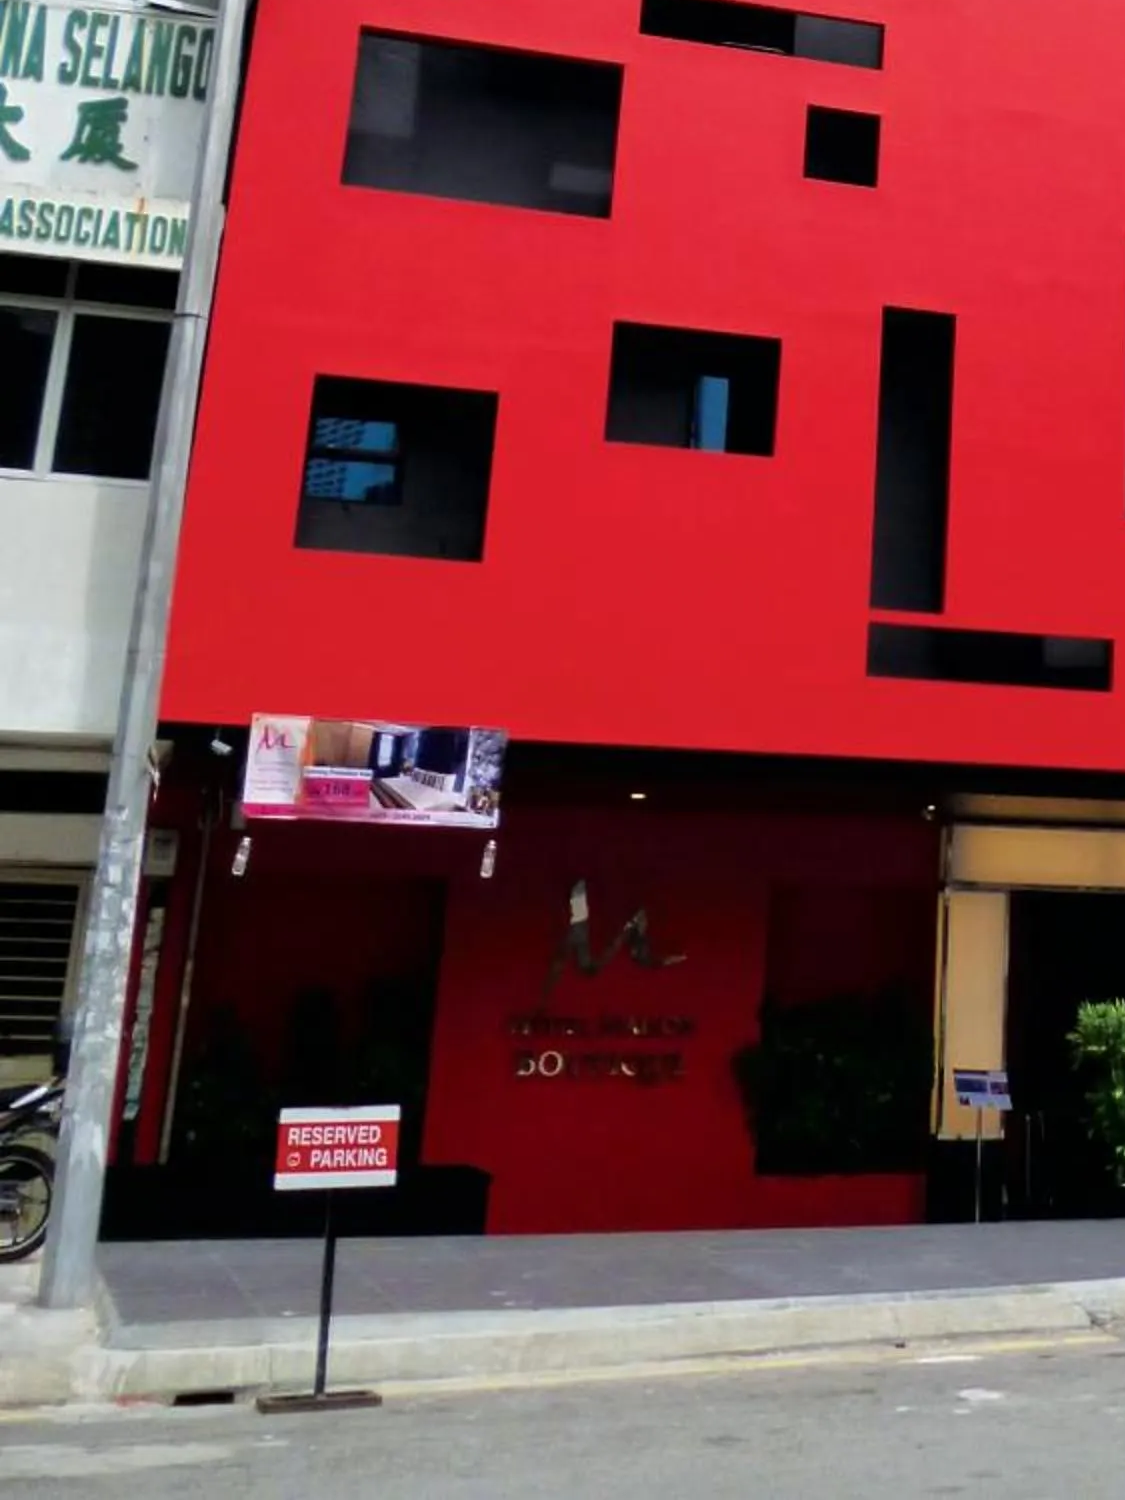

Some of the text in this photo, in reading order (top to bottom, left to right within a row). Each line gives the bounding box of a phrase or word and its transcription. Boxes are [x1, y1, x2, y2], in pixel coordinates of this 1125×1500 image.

[0, 198, 187, 256] ASSOCIATION
[287, 1125, 381, 1146] RESERVED
[310, 1147, 387, 1168] PARKING
